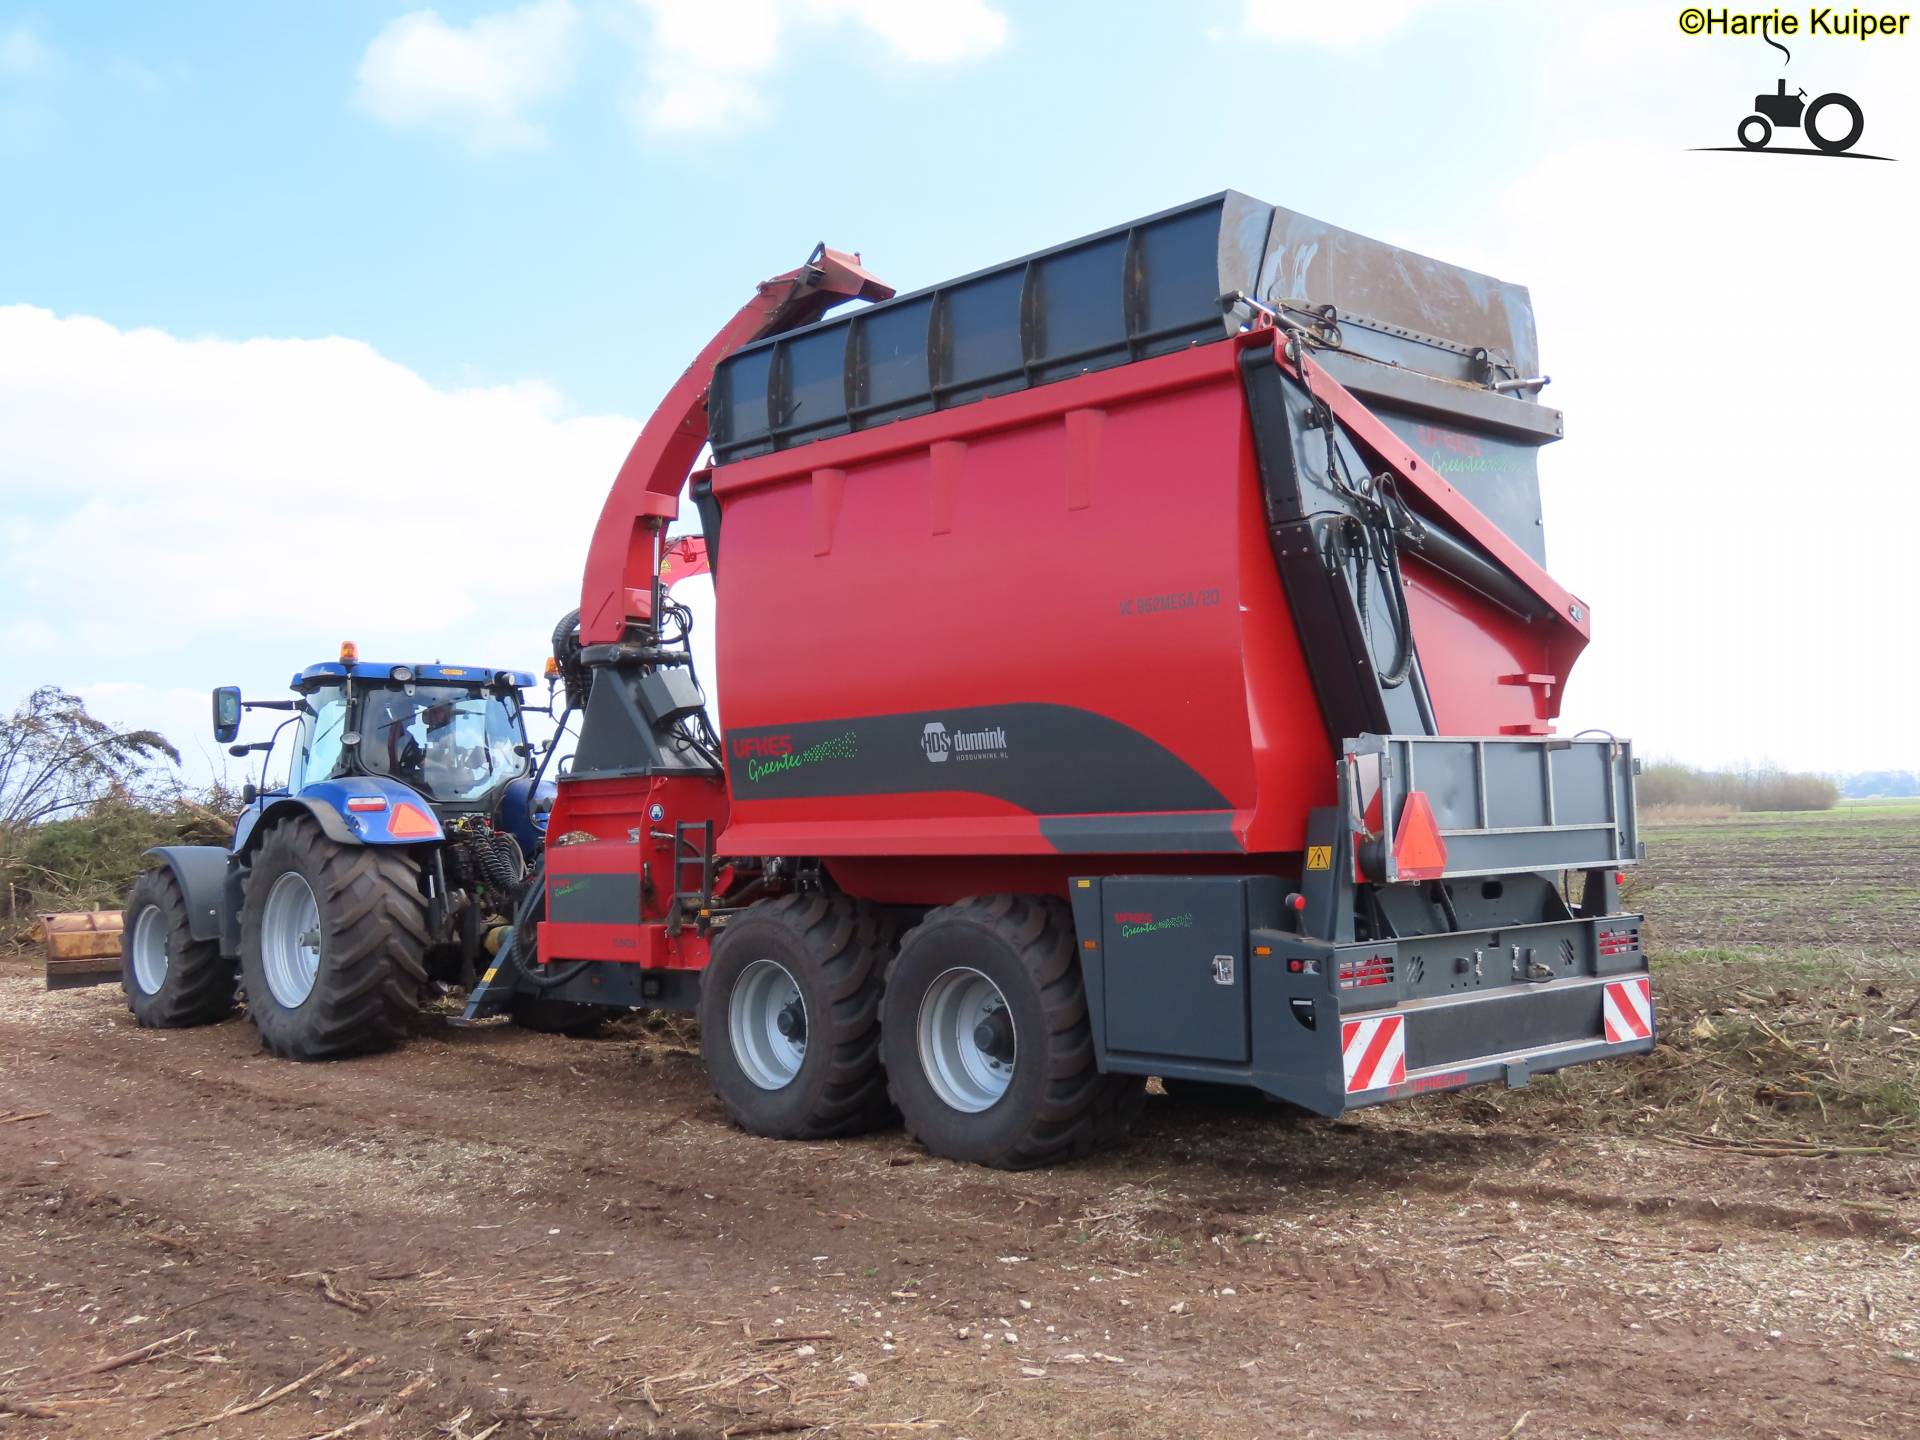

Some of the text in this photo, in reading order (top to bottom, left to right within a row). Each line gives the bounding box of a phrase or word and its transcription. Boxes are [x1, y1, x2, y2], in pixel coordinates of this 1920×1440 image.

[733, 734, 794, 759] UFKES
[922, 729, 951, 754] HDS
[954, 727, 1007, 751] dunnink
[748, 752, 802, 783] Greentec
[1122, 922, 1156, 938] Greentec
